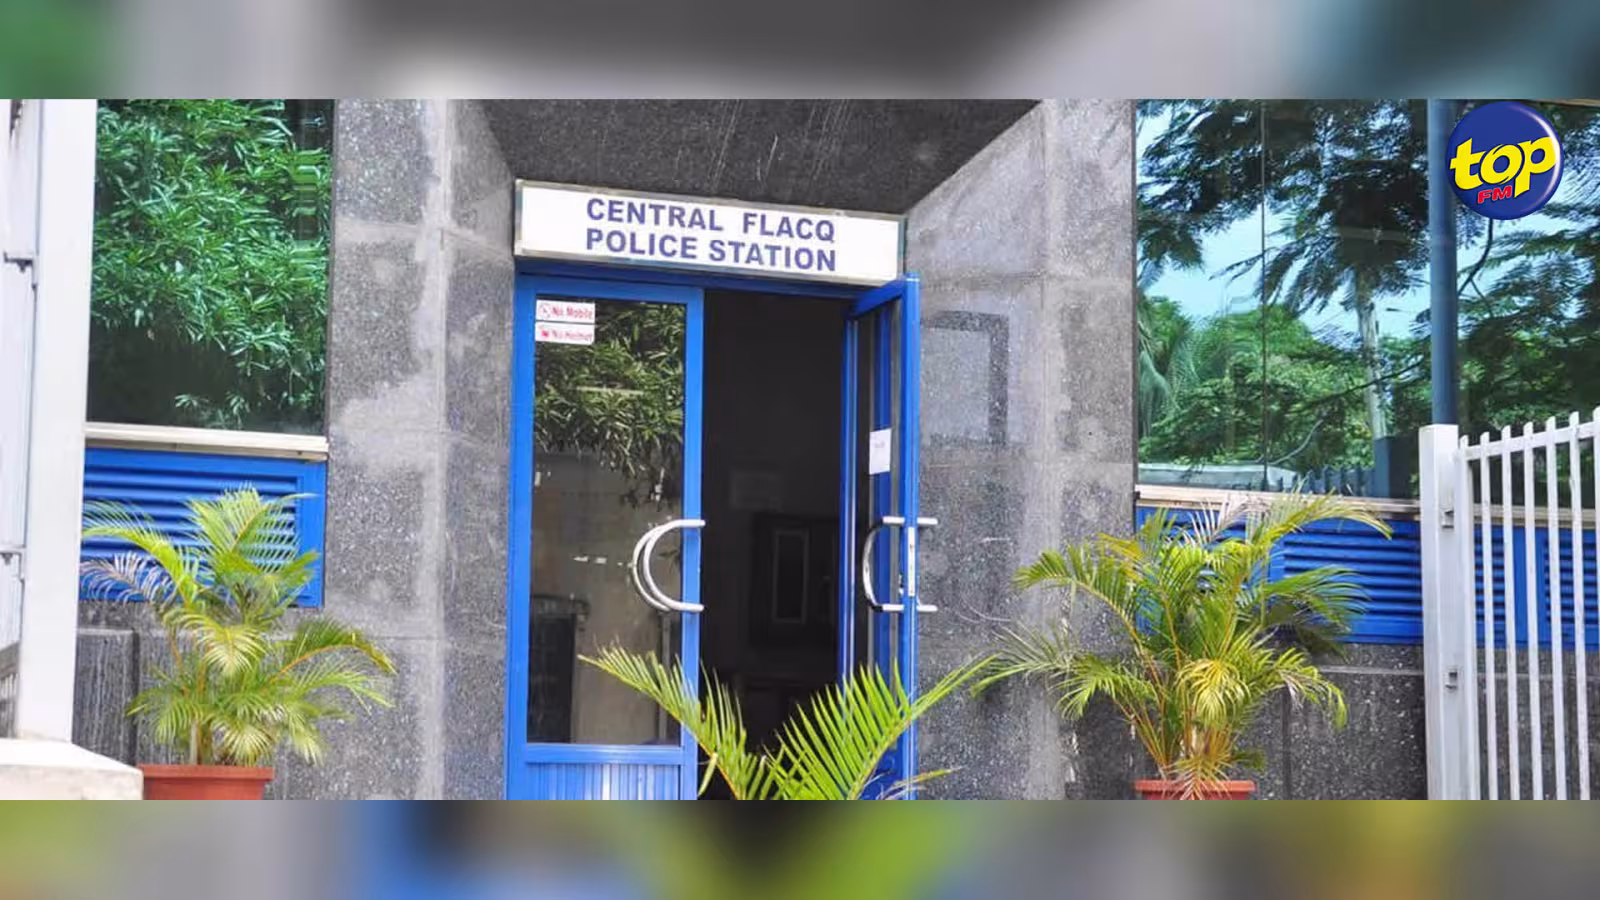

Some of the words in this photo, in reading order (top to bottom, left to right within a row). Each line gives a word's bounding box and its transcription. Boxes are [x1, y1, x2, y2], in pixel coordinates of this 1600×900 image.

[587, 198, 723, 231] CENTRAL
[743, 212, 835, 243] FLACQ
[587, 228, 698, 259] POLICE
[709, 240, 836, 272] STATION
